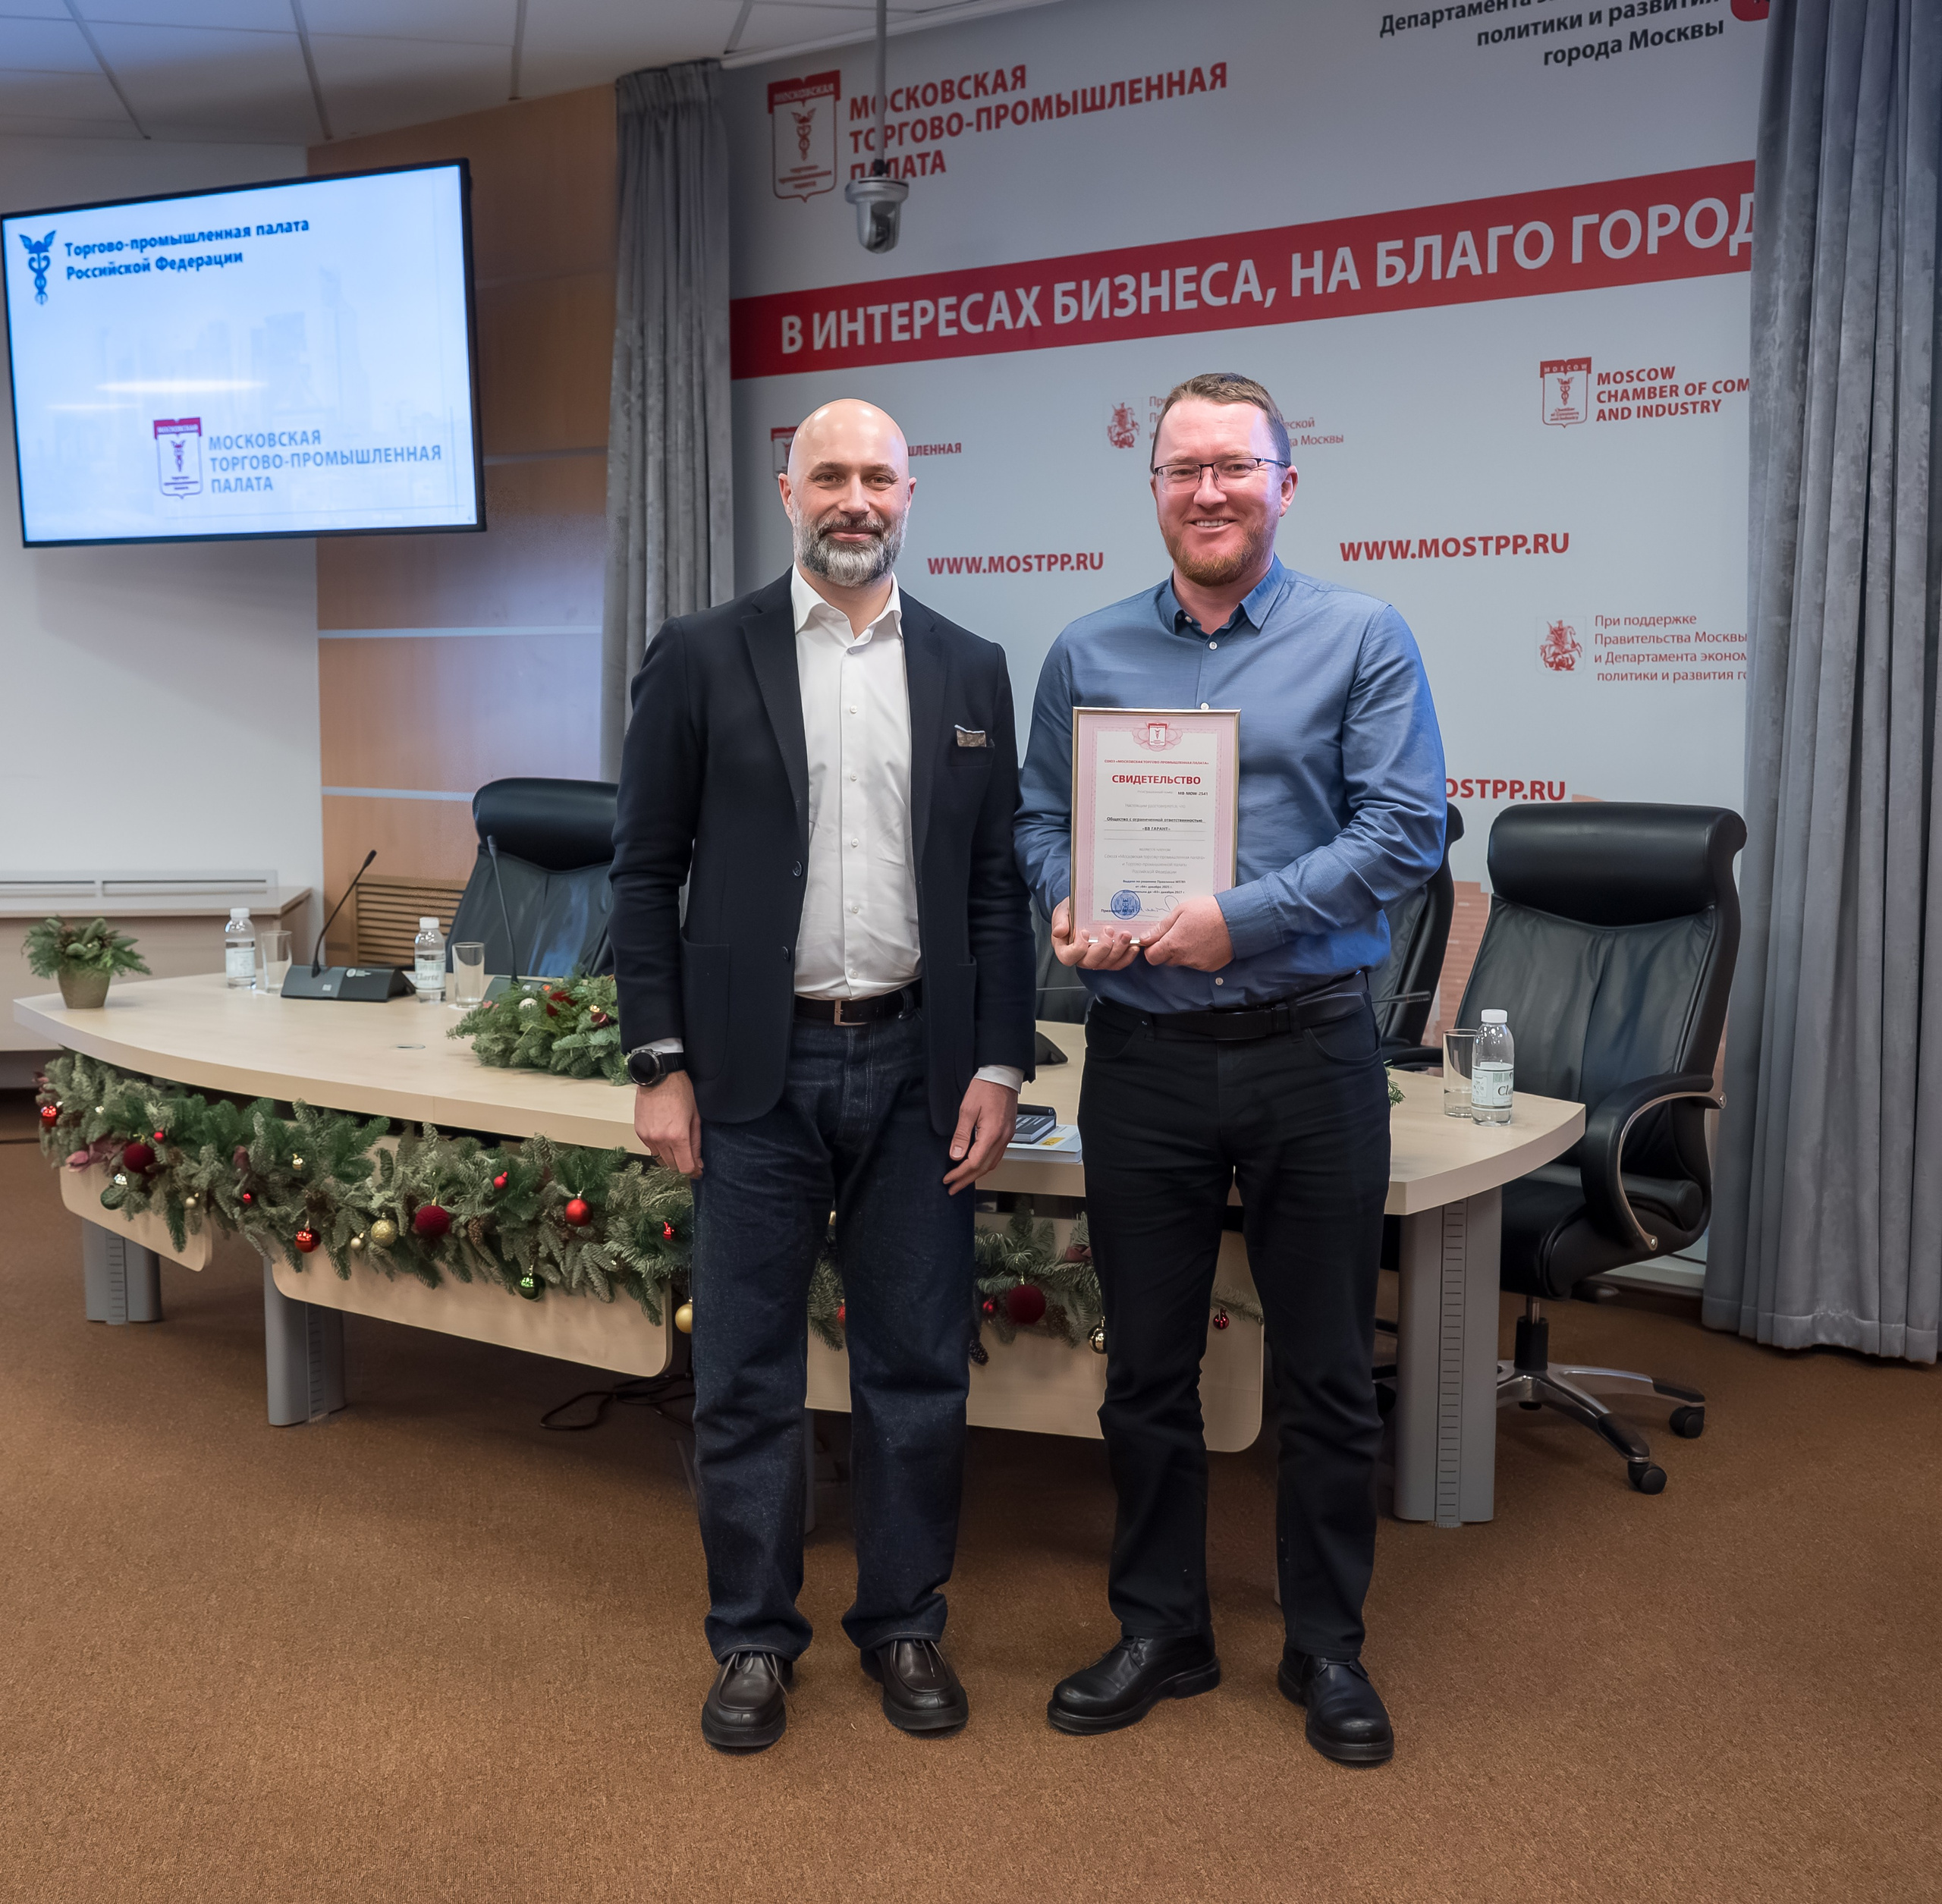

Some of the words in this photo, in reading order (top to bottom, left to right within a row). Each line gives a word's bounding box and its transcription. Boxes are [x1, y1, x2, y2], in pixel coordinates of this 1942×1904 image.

[1477, 14, 1582, 46] политики
[1588, 9, 1602, 26] и
[1608, 0, 1720, 27] развит
[1544, 38, 1622, 67] города
[1629, 20, 1724, 51] Москвы
[850, 62, 1227, 153] ТОРГОВО-ПРОМЫШЛЕННАЯ
[64, 226, 251, 259] Торгово-промышленная
[256, 220, 310, 236] палата
[67, 258, 151, 280] Российской
[156, 251, 243, 272] Федерации
[781, 315, 803, 353] В
[813, 286, 1042, 350] ИНТЕРЕСАХ
[1054, 258, 1276, 324] БИЗНЕСА,
[1291, 247, 1361, 297] НА
[1376, 221, 1554, 287] БЛАГО
[1597, 366, 1676, 386] MOSCOW
[1596, 384, 1680, 404] CHAMBER
[1684, 382, 1707, 397] OF
[1596, 406, 1632, 422] AND
[1636, 398, 1722, 419] INDUSTRY
[209, 429, 322, 451] МОСКОВСКАЯ
[1301, 435, 1343, 445] Москвы
[210, 445, 442, 473] ТОРГОВО-ПРОМЫШЛЕННАЯ
[212, 476, 273, 494] ПАЛАТА
[1340, 533, 1570, 561] WWW.MOSTPP.RU
[928, 551, 1104, 575] WWW.MOSTPP.RU
[1595, 614, 1620, 629] При
[1624, 615, 1697, 628] поддержке
[1595, 633, 1691, 647] Правительства
[1695, 631, 1748, 643] Москвы
[1595, 654, 1601, 663] и
[1605, 652, 1697, 665] Департамента
[1597, 671, 1658, 681] политики
[1662, 671, 1669, 680] и
[1673, 671, 1733, 683] развития
[1111, 774, 1201, 784] СВИДЕТЕЛЬСТВО
